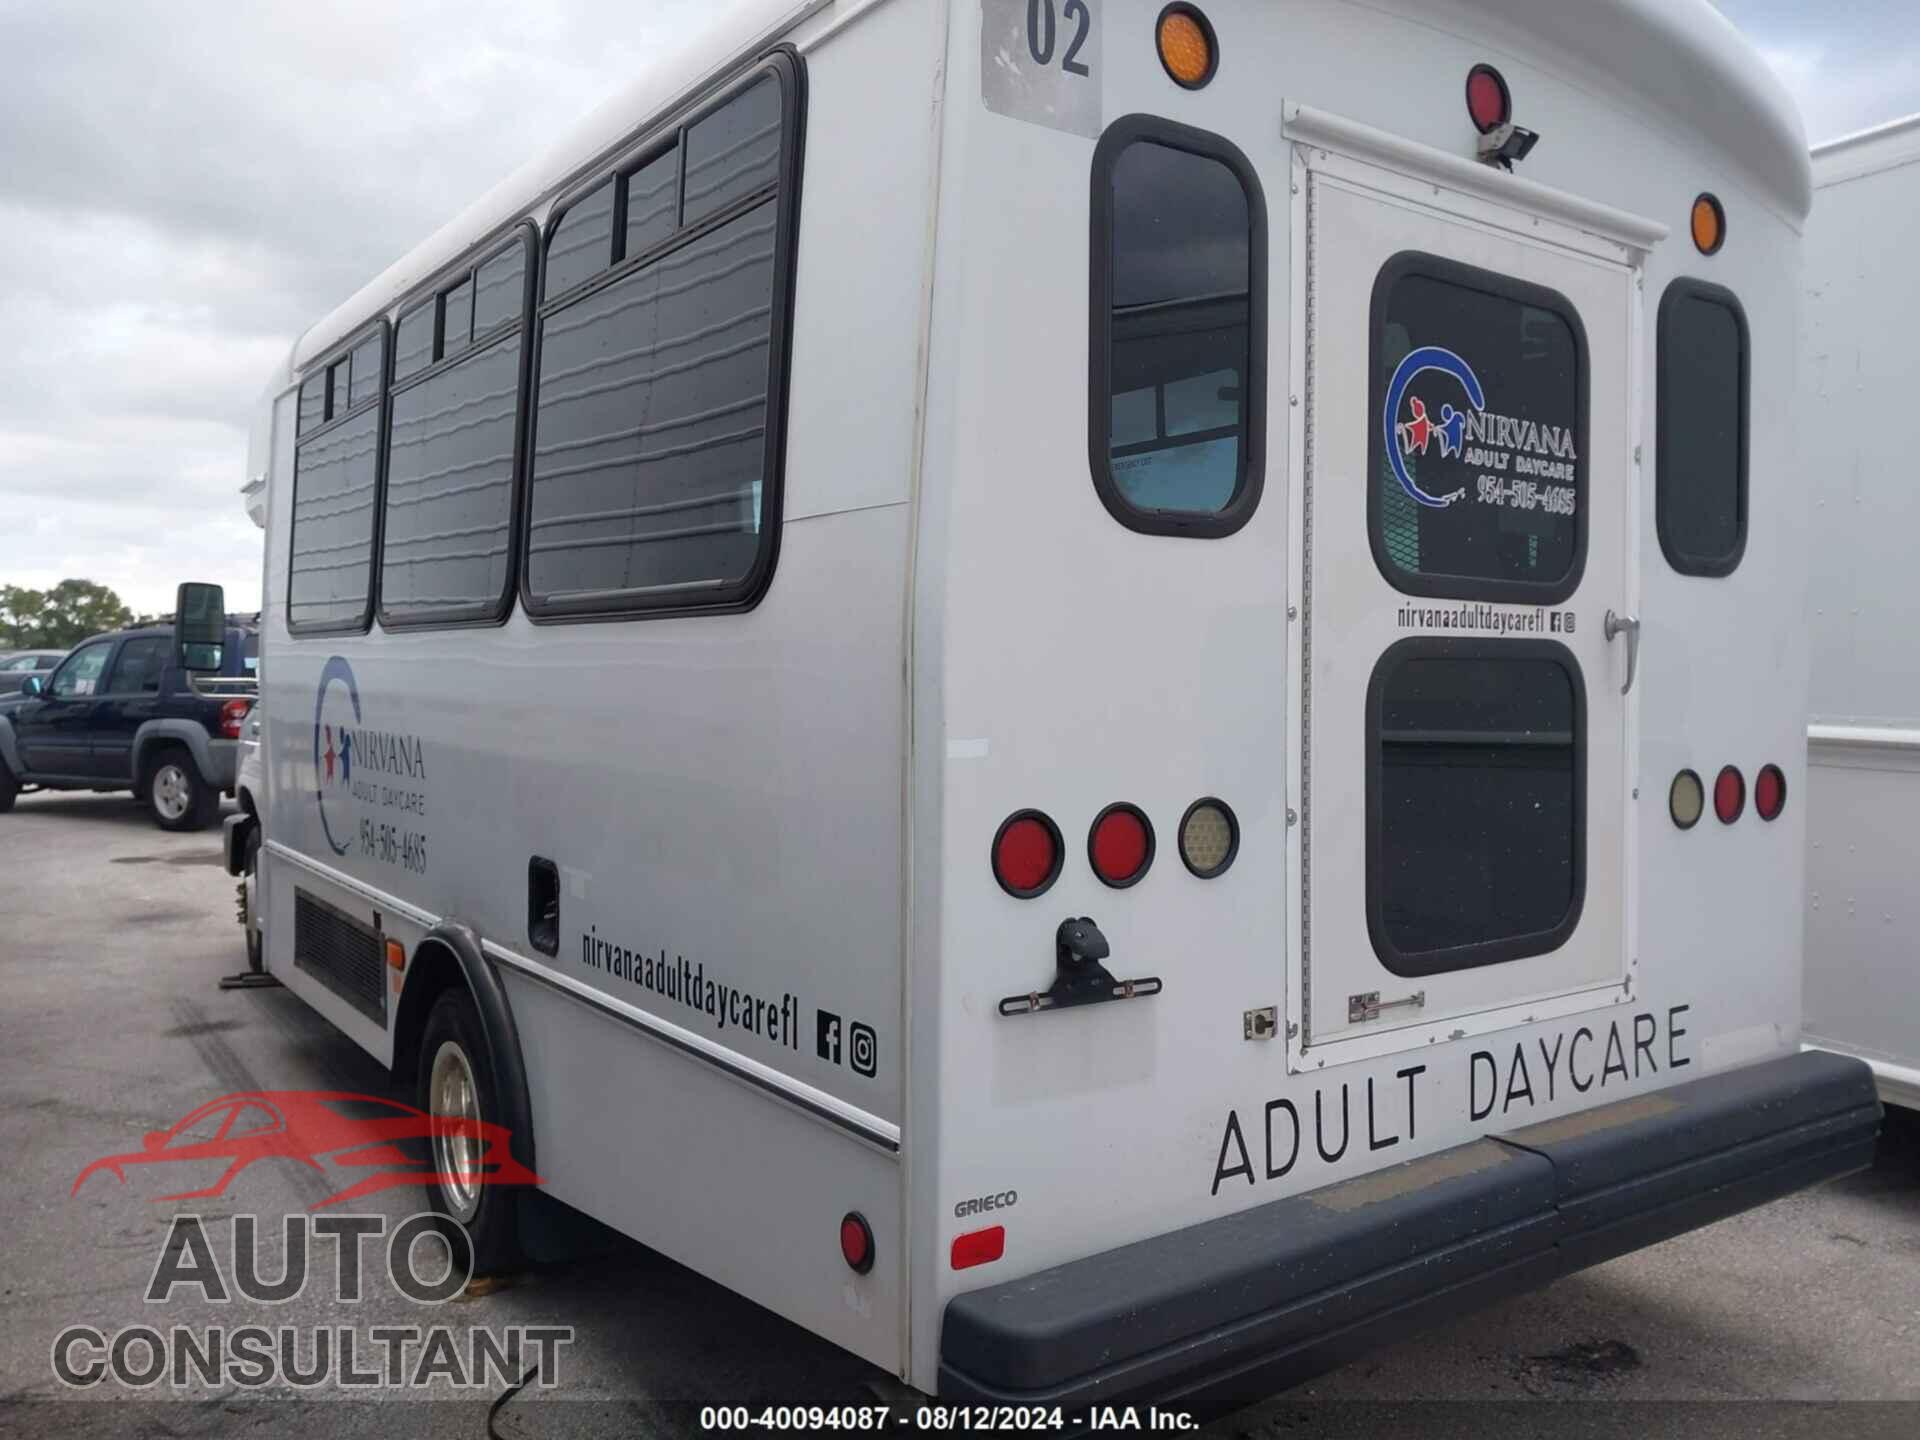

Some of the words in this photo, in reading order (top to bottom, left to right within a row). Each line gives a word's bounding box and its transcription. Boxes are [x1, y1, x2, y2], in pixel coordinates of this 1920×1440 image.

[1027, 0, 1090, 77] 02
[1465, 409, 1576, 459] NIRVANA
[1464, 446, 1510, 470] ADULT
[1516, 455, 1574, 481] DAYCARE
[1477, 474, 1575, 515] 954-505-4685
[1397, 601, 1544, 634] nirvanaadultdaycarefl
[352, 730, 426, 779] NIRVANA
[382, 786, 425, 816] DAYCARE
[360, 818, 426, 874] 954-505-4685
[582, 925, 799, 1050] nirvanaadultdaycarefl
[1212, 1065, 1427, 1196] ADULT
[1469, 1004, 1691, 1122] DAYCARE
[954, 1190, 1018, 1218] GRIECO
